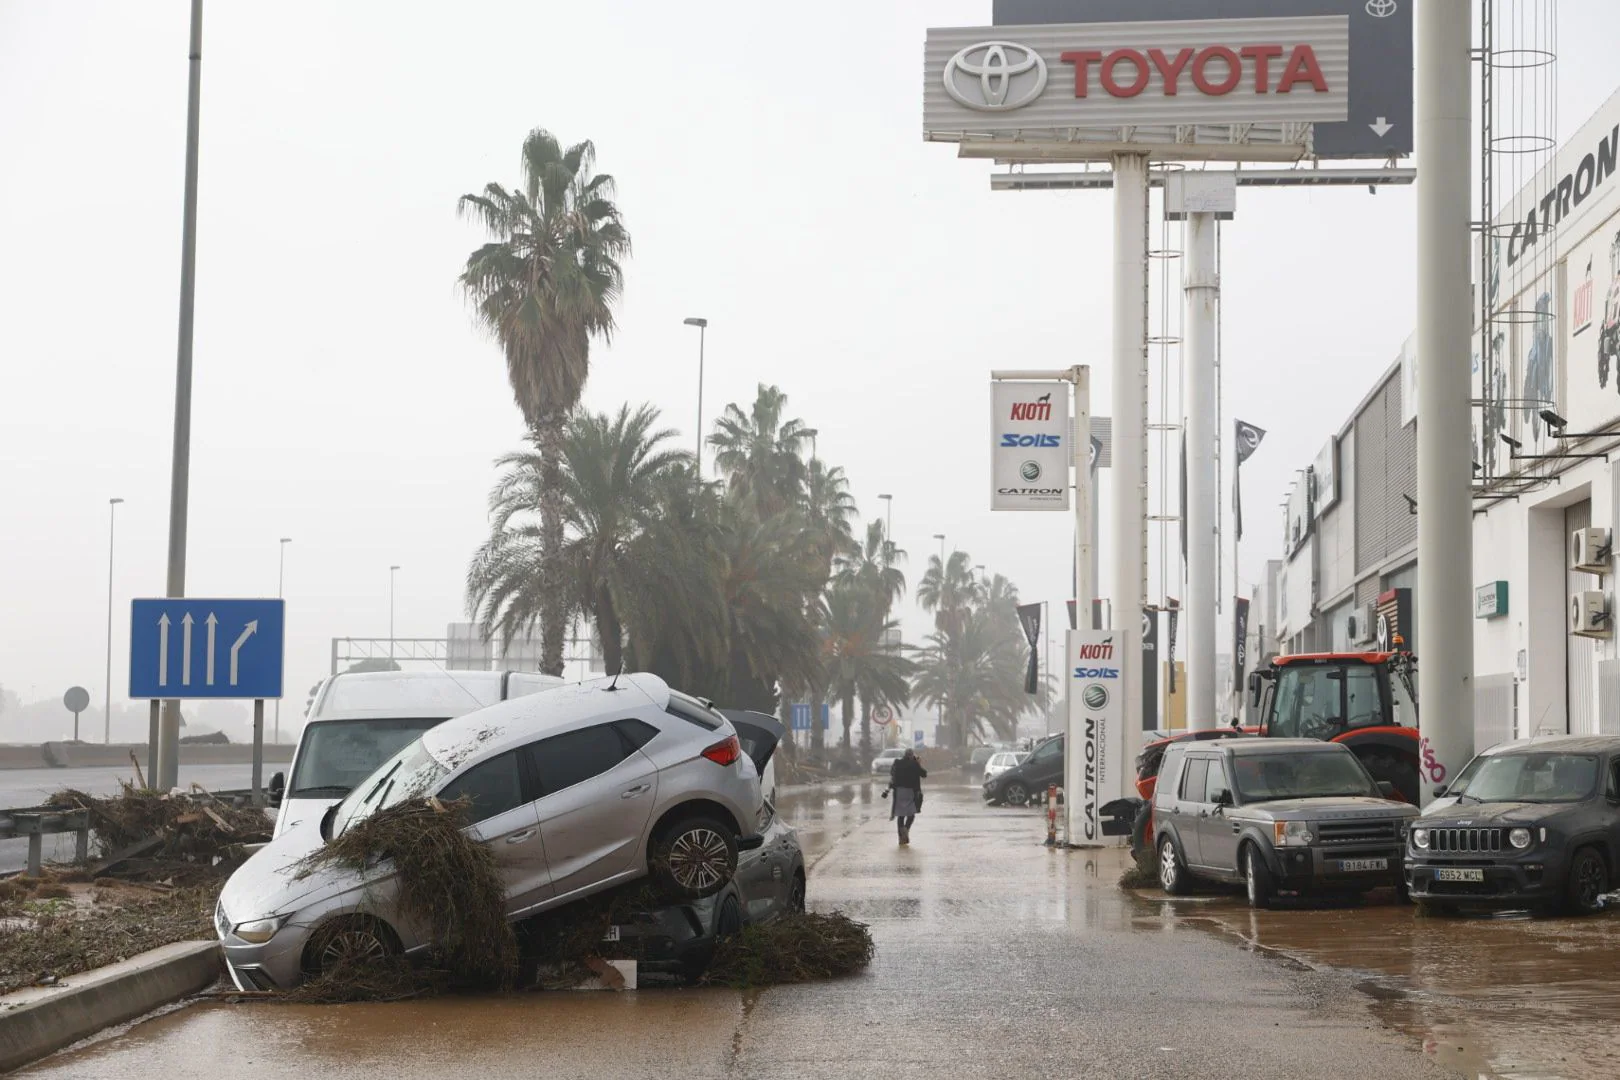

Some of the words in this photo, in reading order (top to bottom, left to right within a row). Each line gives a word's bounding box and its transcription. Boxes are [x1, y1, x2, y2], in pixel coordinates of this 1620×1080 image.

[1060, 44, 1329, 99] TOYOTA
[1507, 123, 1620, 268] CATRON
[1573, 280, 1594, 331] KIOTI
[1010, 402, 1052, 421] KIOTI
[998, 487, 1064, 495] CATRON
[1080, 644, 1114, 660] KIOTI
[1084, 718, 1096, 841] CATRON
[1345, 861, 1367, 871] 9184
[1440, 869, 1462, 880] 6952
[1463, 869, 1481, 880] WCL
